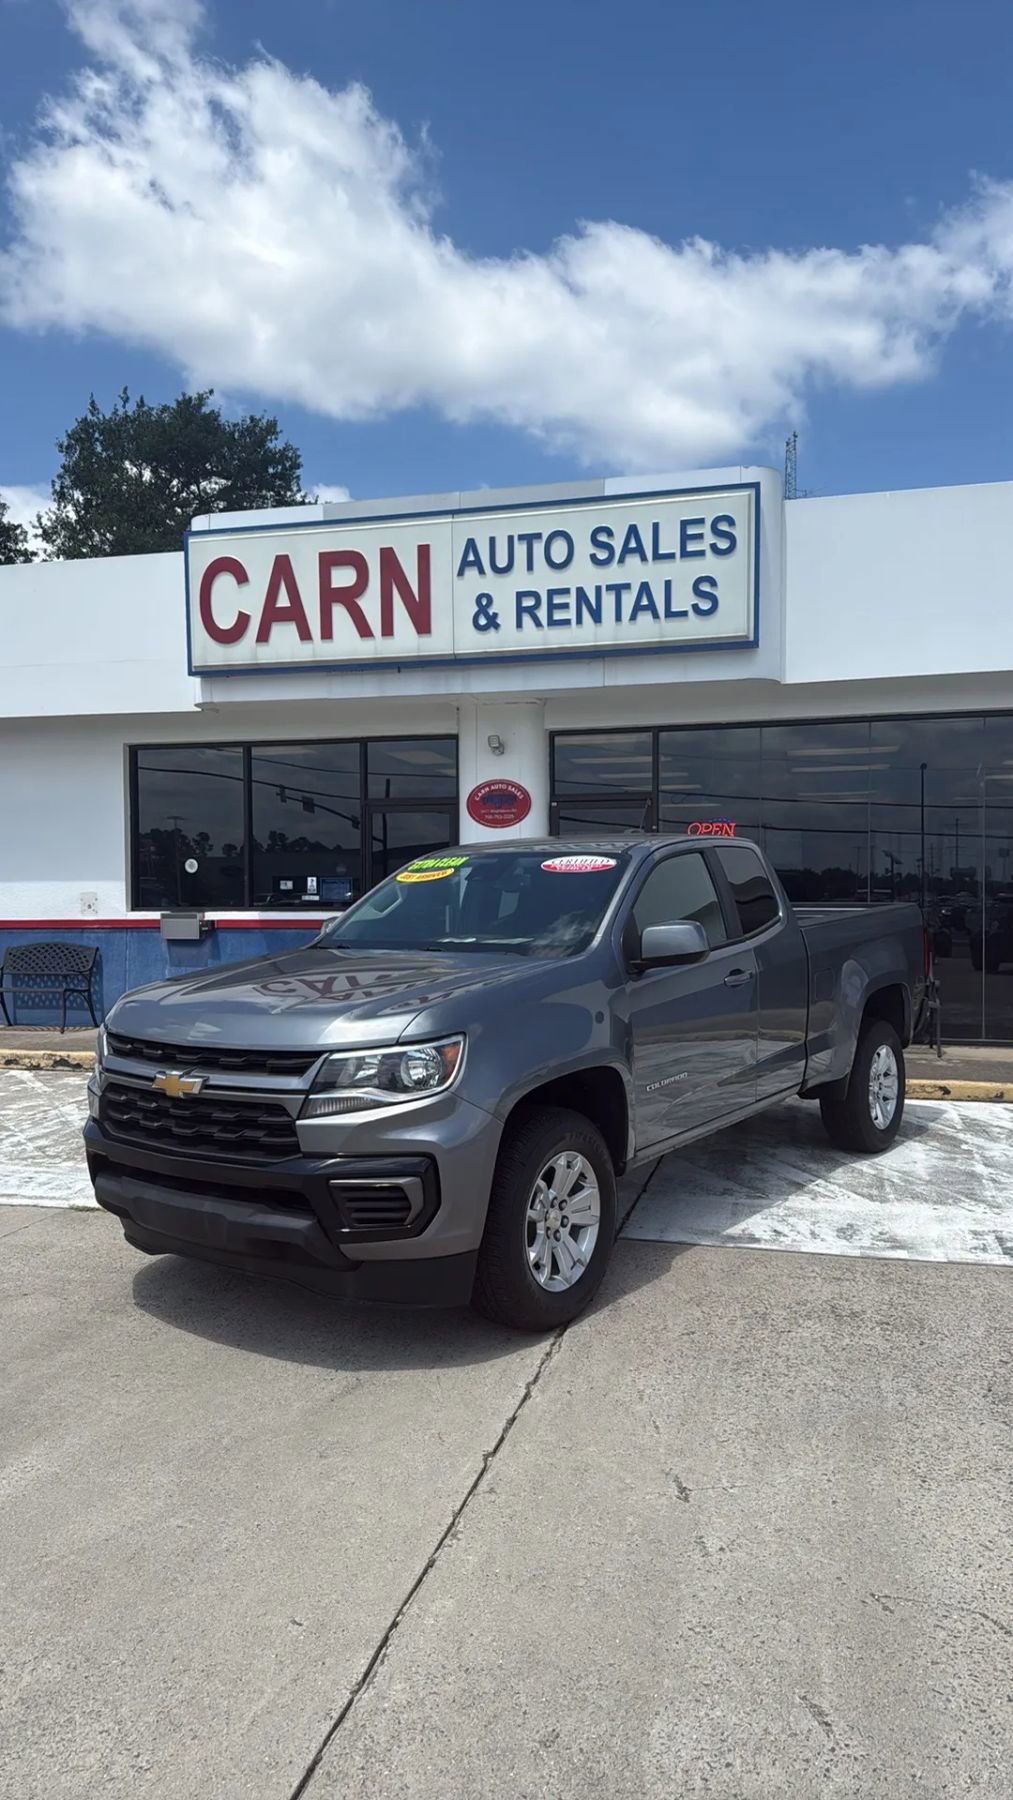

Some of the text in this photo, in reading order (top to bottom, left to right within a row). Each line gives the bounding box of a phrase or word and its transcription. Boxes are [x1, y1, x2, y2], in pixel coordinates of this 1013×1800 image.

[457, 514, 738, 577] AUTO SALES
[199, 544, 431, 644] CARN
[471, 575, 719, 632] & RENTALS
[474, 787, 490, 800] CARN
[508, 785, 525, 799] SALES
[687, 822, 737, 838] OPEN
[646, 1072, 688, 1091] COLORADO
